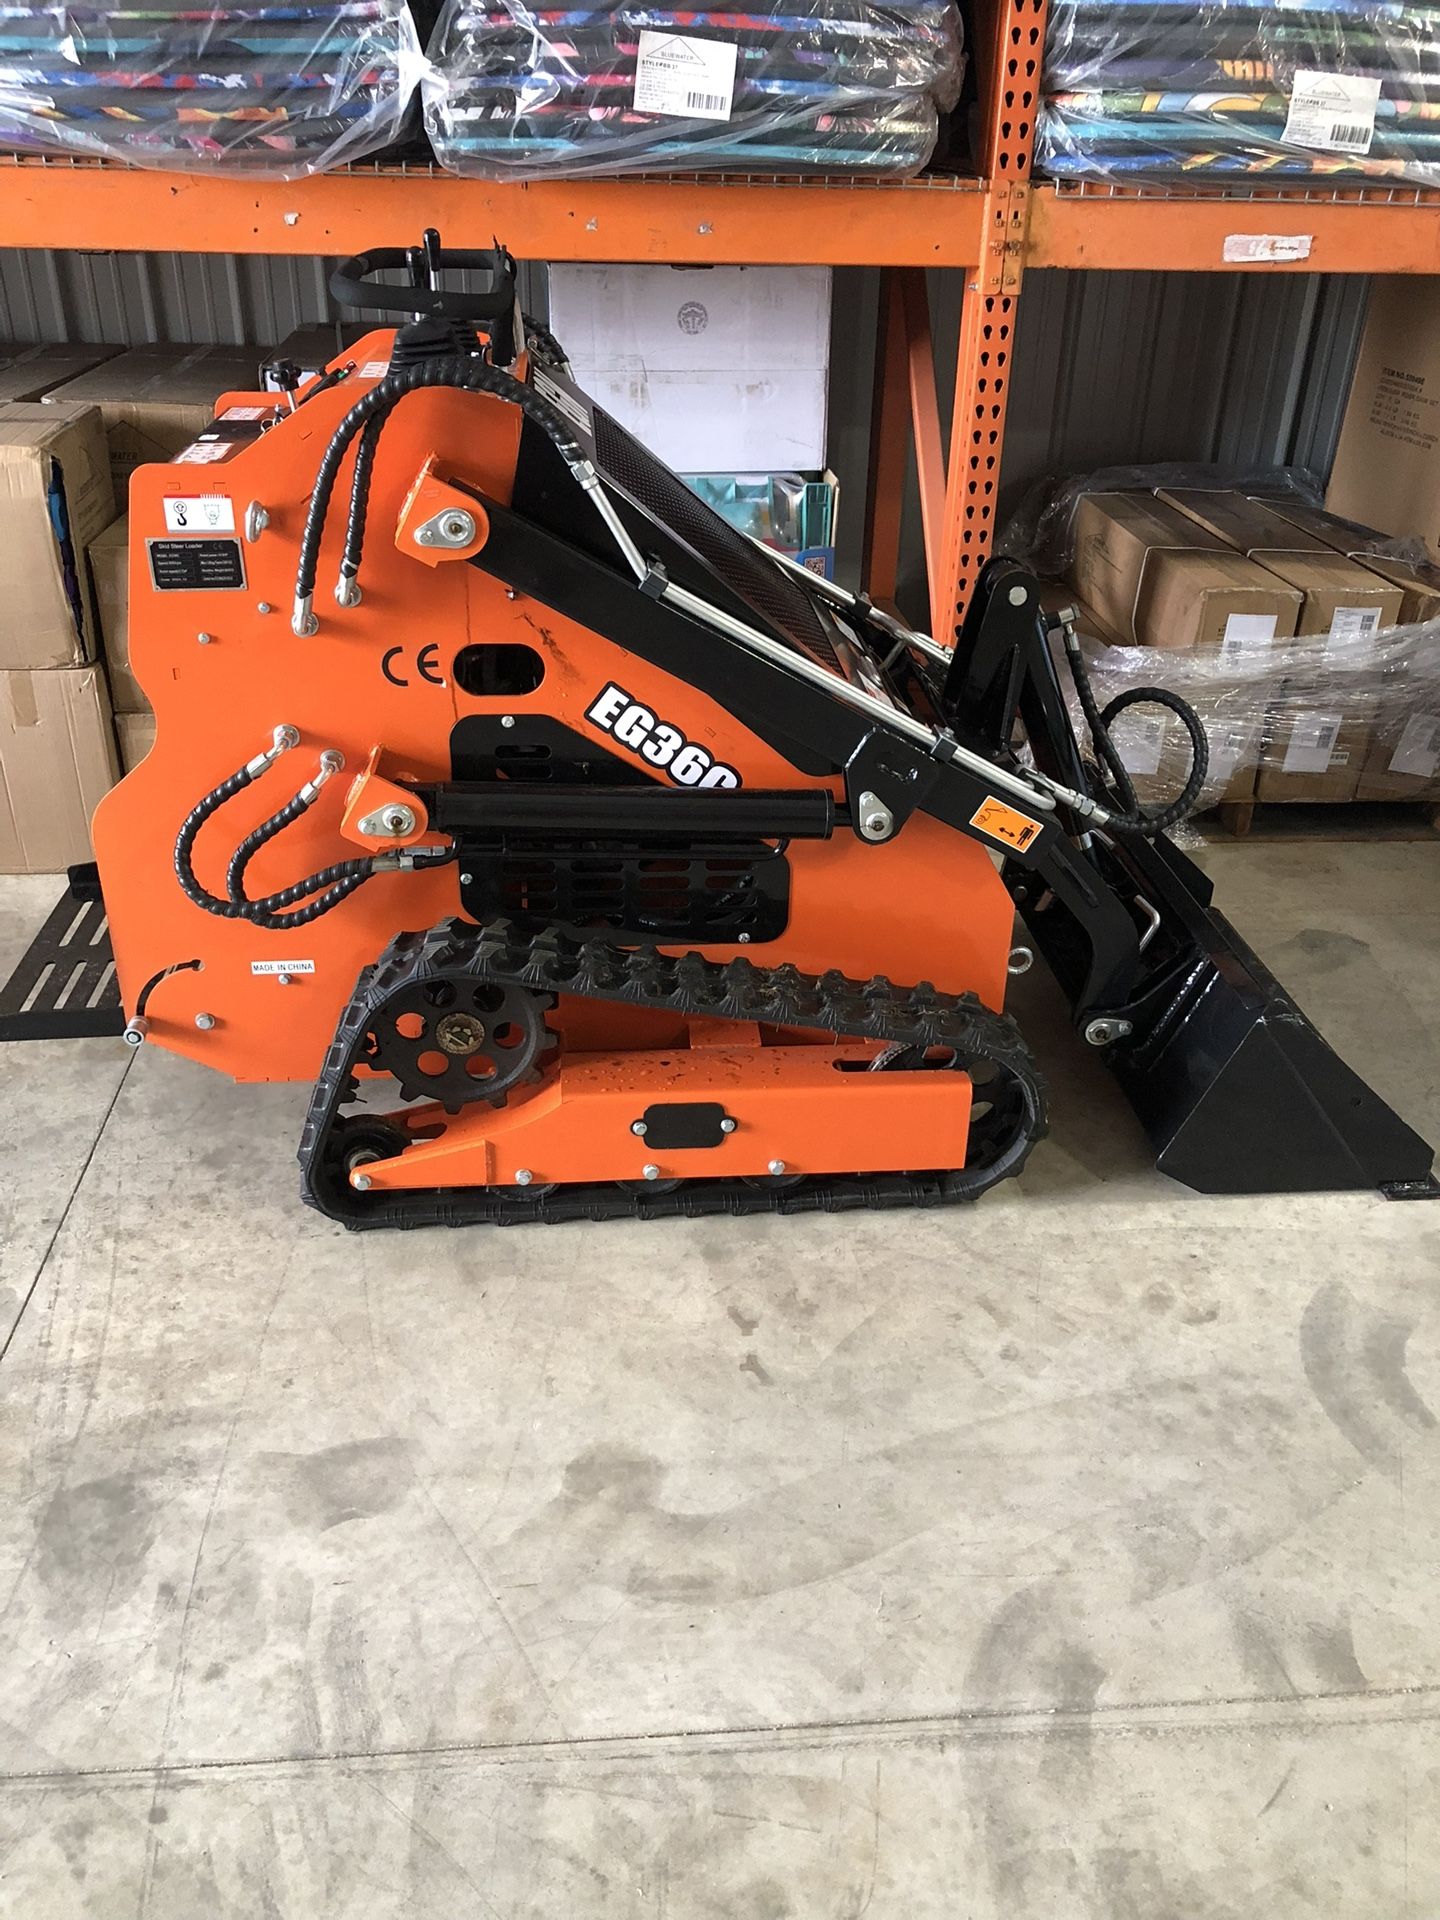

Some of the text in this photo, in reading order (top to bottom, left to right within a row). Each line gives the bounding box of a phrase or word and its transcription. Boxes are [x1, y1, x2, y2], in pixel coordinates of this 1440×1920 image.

[660, 51, 694, 60] BLUEWATER
[253, 962, 313, 972] MADE IN CHINA
